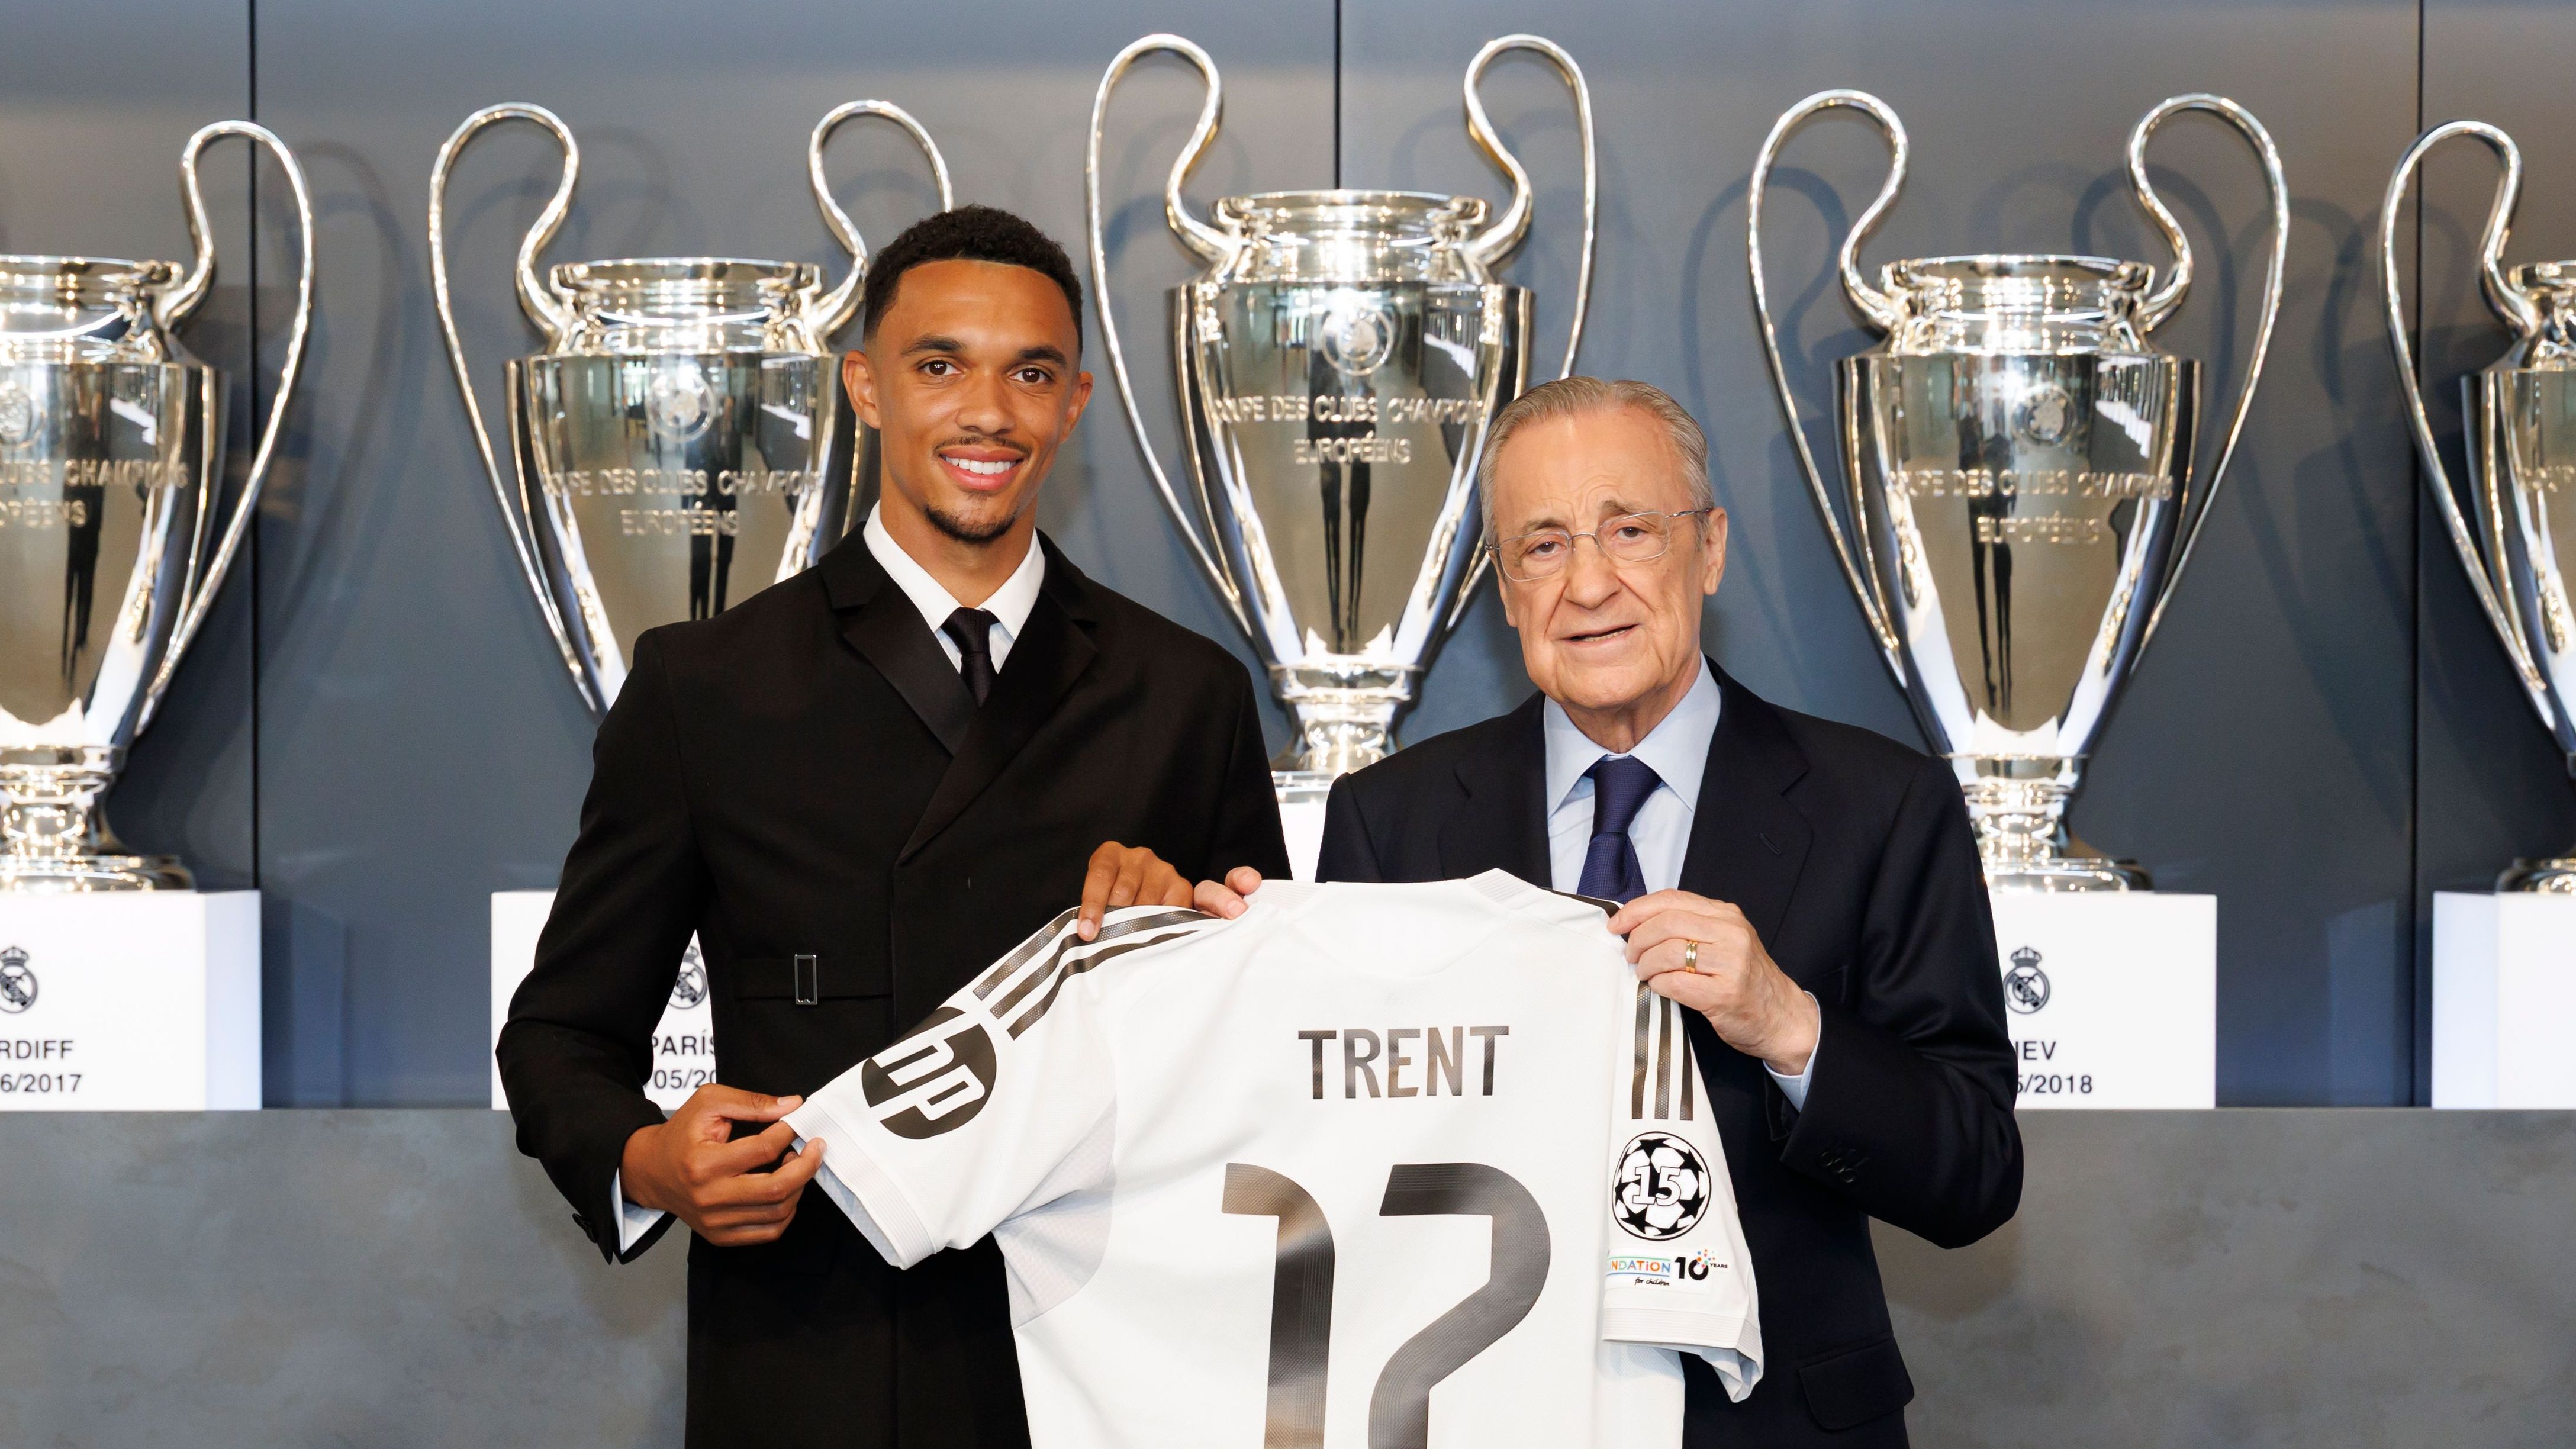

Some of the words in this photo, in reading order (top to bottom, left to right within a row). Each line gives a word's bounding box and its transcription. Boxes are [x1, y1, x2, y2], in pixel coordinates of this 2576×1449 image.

[1270, 395, 1309, 422] DES
[1313, 395, 1379, 423] CLUBS
[599, 468, 637, 495] DES
[642, 468, 709, 496] CLUBS
[1952, 469, 1994, 497] DES
[1998, 469, 2068, 496] CLUBS
[870, 1012, 986, 1122] hp
[1298, 1026, 1509, 1099] TRENT
[0, 1073, 82, 1093] 6/2017
[1632, 1165, 1682, 1207] 15
[1635, 1276, 1644, 1286] for
[1646, 1277, 1670, 1286] children
[1675, 1256, 1709, 1281] 10
[1222, 1163, 1551, 1449] 12
